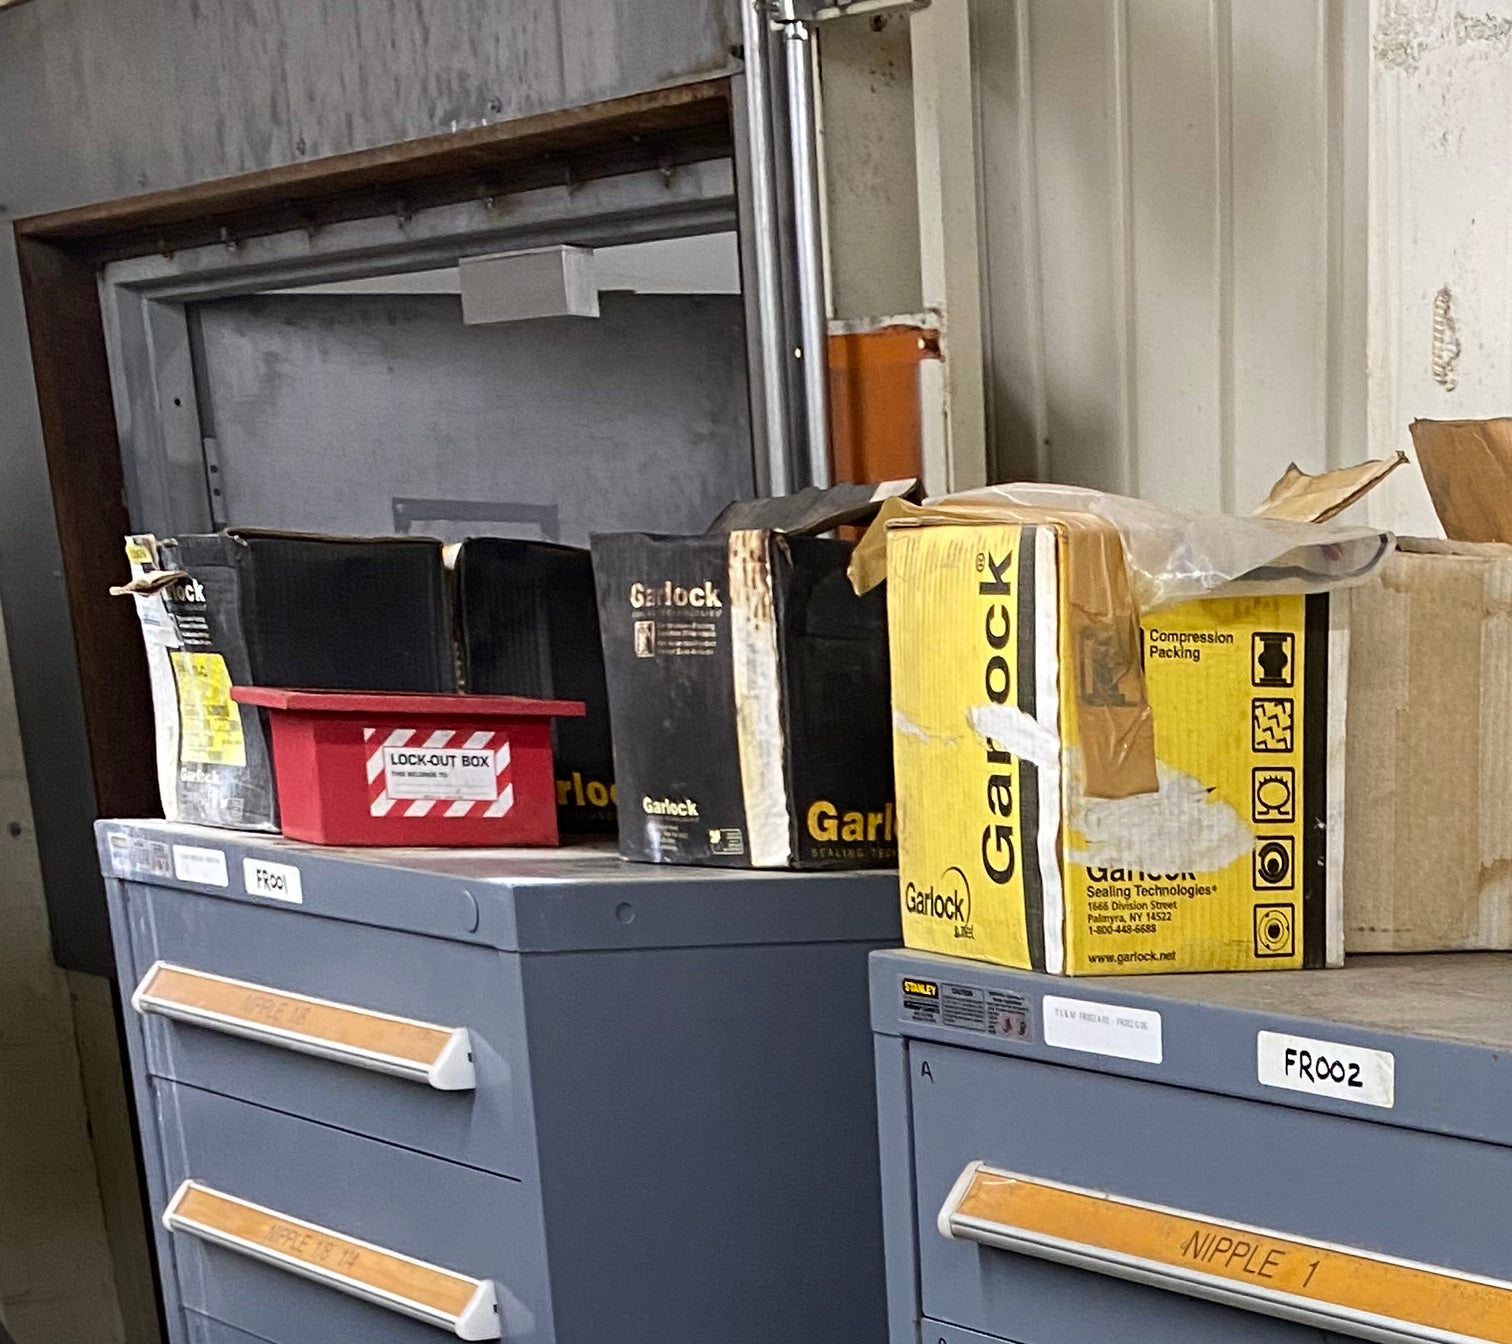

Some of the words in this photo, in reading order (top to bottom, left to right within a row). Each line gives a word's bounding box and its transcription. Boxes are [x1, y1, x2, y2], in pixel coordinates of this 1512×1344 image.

[1150, 628, 1234, 647] Compression
[1150, 645, 1201, 662] Packing
[979, 549, 1016, 886] Garock
[390, 753, 457, 768] LOCK-OUT
[462, 755, 490, 768] BOX
[642, 797, 699, 817] Garlock
[807, 800, 898, 842] Garl
[905, 882, 965, 922] Garlock
[1087, 886, 1131, 899] Sealing
[1112, 901, 1148, 910] Division
[1151, 901, 1177, 910] Street
[1130, 913, 1142, 922] NY
[920, 1060, 935, 1084] A
[1284, 1048, 1364, 1088] FR002
[1183, 1230, 1285, 1280] NIPPLE
[1301, 1260, 1321, 1290] 1
